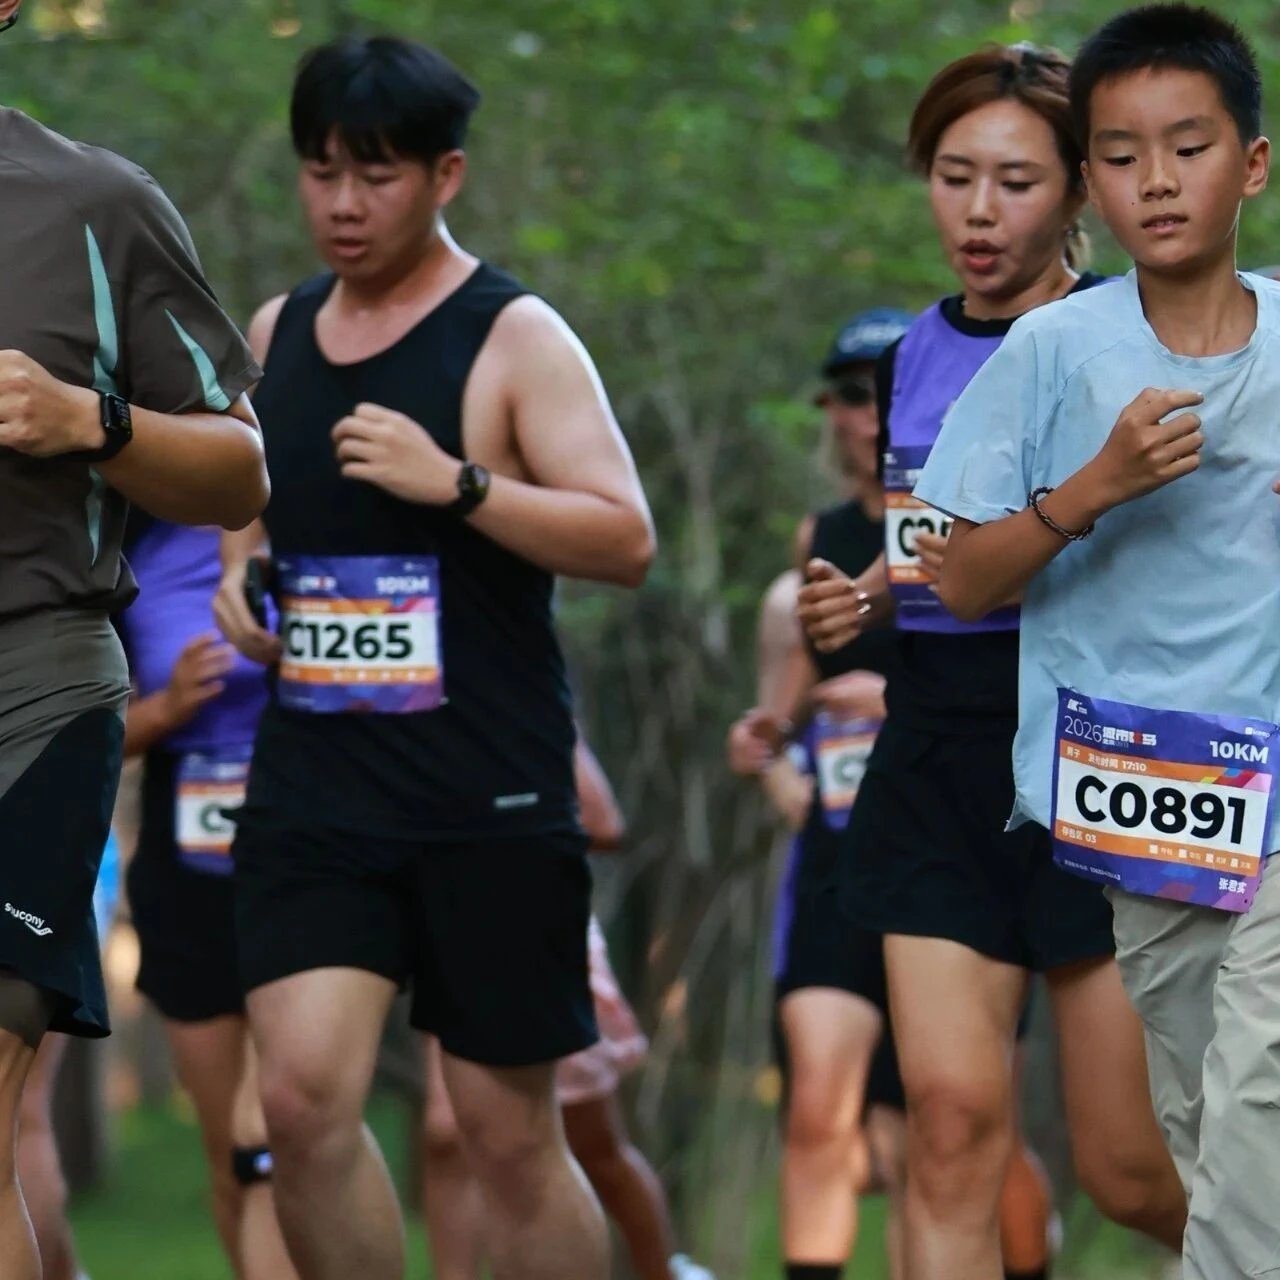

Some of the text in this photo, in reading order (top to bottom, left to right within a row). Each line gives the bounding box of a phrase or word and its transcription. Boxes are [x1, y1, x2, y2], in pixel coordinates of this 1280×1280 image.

[287, 621, 414, 660] C1265
[1064, 715, 1103, 743] 2026
[1121, 759, 1148, 773] 17:10
[1209, 740, 1270, 764] 10KM
[1075, 775, 1246, 845] C0891
